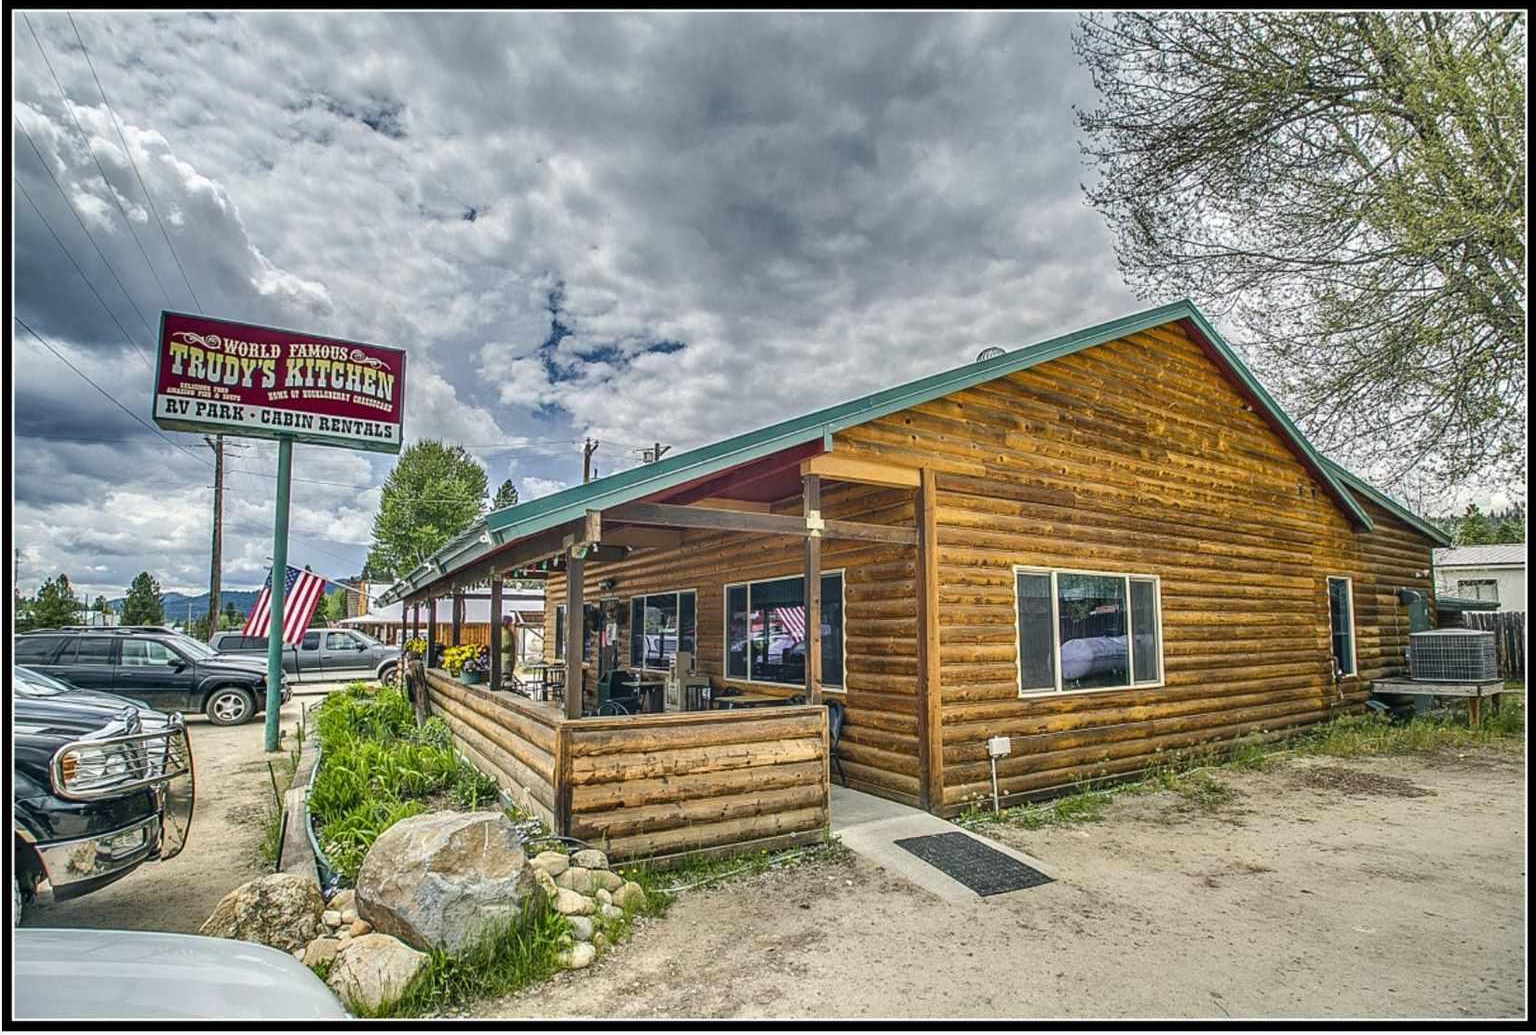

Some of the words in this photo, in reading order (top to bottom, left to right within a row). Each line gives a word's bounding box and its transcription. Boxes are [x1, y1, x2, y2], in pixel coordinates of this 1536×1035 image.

[223, 338, 281, 358] WORLD
[289, 344, 349, 361] FAMOUS
[169, 341, 276, 389] TRUDY'S
[285, 358, 395, 402] KITCHEN
[267, 390, 289, 402] HOME
[290, 389, 300, 399] OF
[302, 389, 350, 403] HUCKLEBERRY
[165, 398, 190, 415] RV
[195, 402, 245, 422] PARK
[261, 409, 314, 430] CABIN
[319, 417, 393, 439] RENTALS
